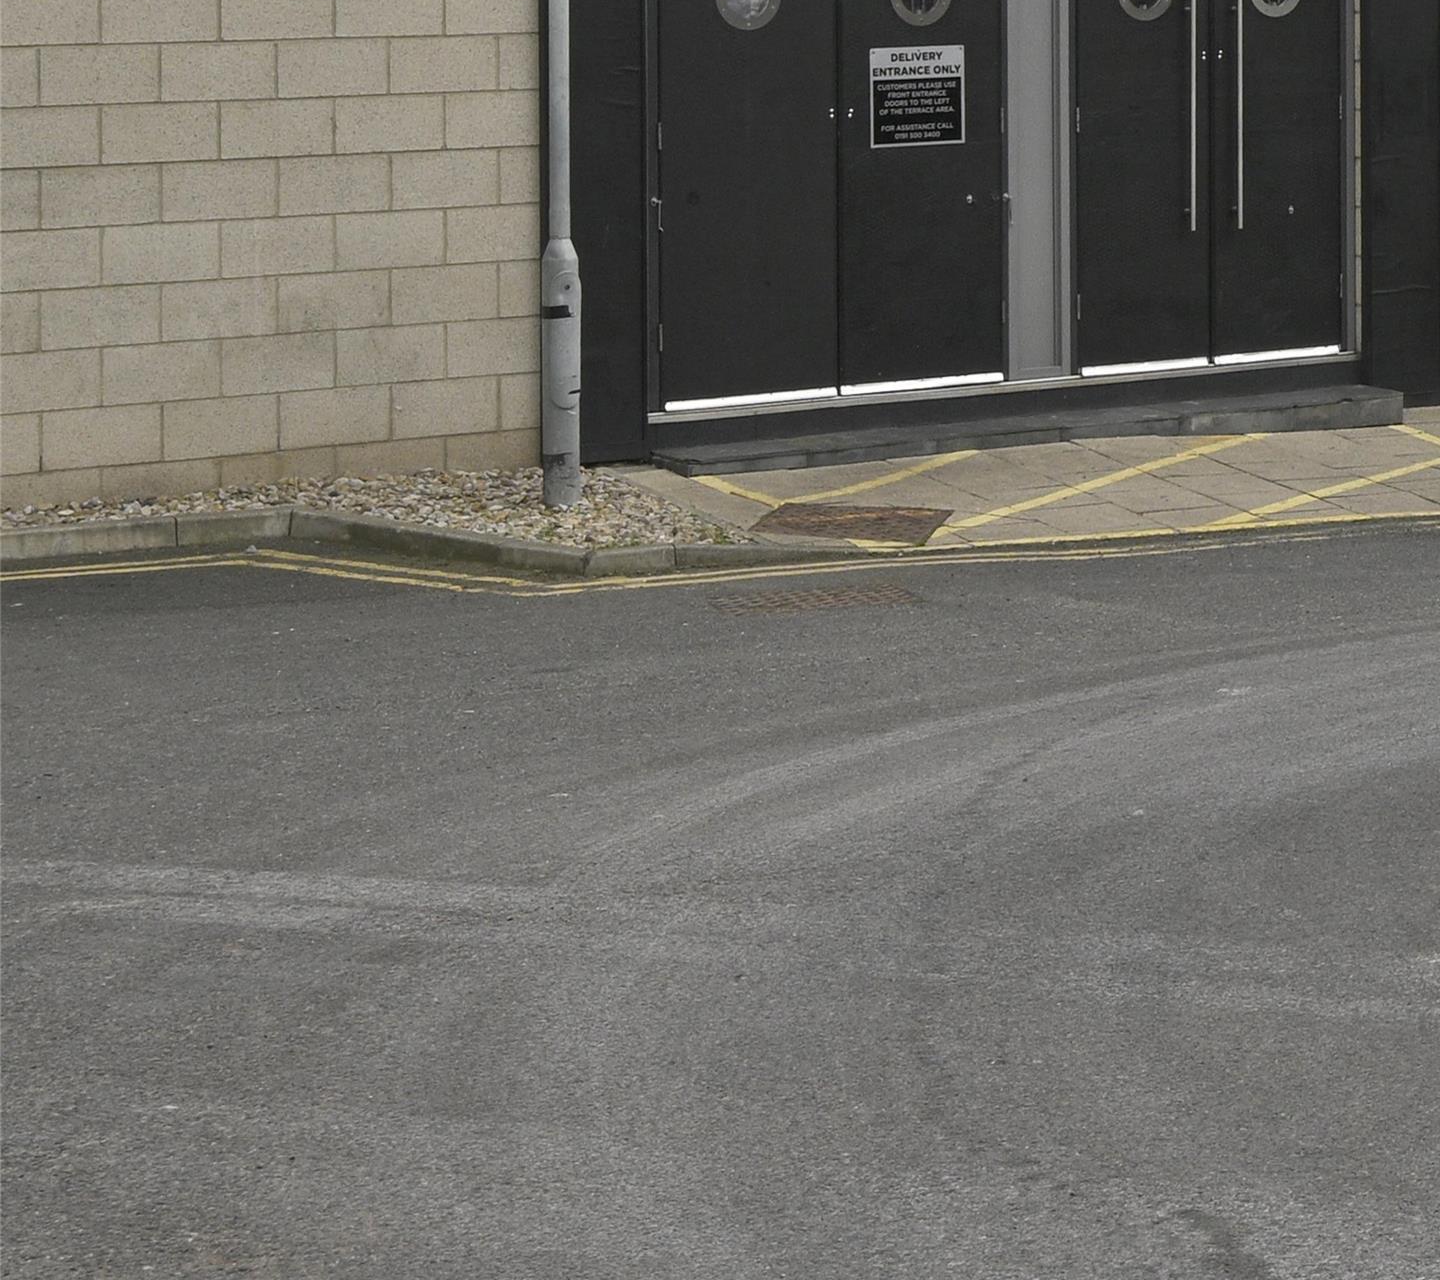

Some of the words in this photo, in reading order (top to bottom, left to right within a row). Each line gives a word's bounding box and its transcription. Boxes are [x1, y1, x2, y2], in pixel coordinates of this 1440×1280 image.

[891, 51, 943, 62] DELIVERY
[873, 66, 931, 77] ENTRANCE
[933, 64, 961, 75] ONLY
[877, 83, 917, 91] CUSTOMERS
[911, 90, 947, 98] ENTRANCE
[884, 99, 908, 107] DOORS
[934, 97, 950, 105] LEFT
[904, 107, 934, 115] TERRACE
[896, 123, 936, 131] ASSISTANCE
